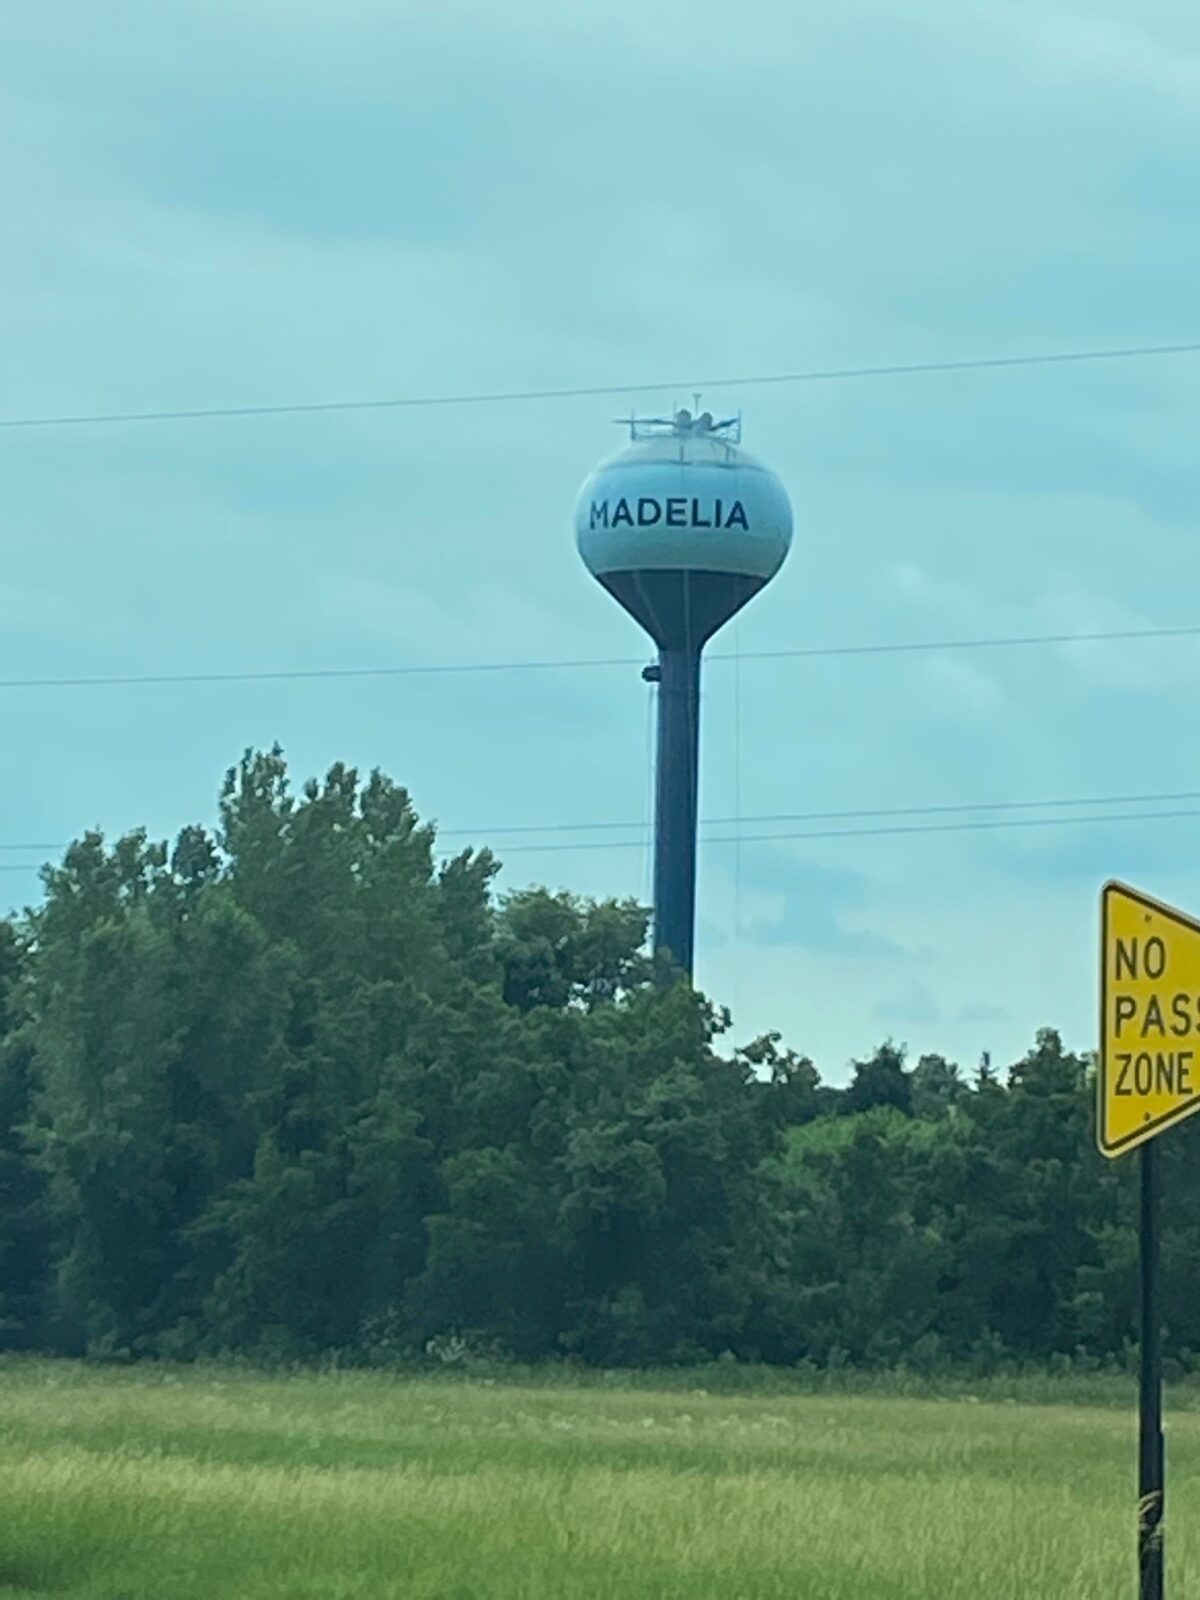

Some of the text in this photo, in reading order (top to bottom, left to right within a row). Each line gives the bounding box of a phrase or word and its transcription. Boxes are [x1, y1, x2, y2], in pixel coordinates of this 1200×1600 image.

[590, 498, 749, 531] MADELIA
[1115, 936, 1166, 981] NO
[1115, 993, 1200, 1038] PAS
[1114, 1052, 1194, 1096] ZONE
